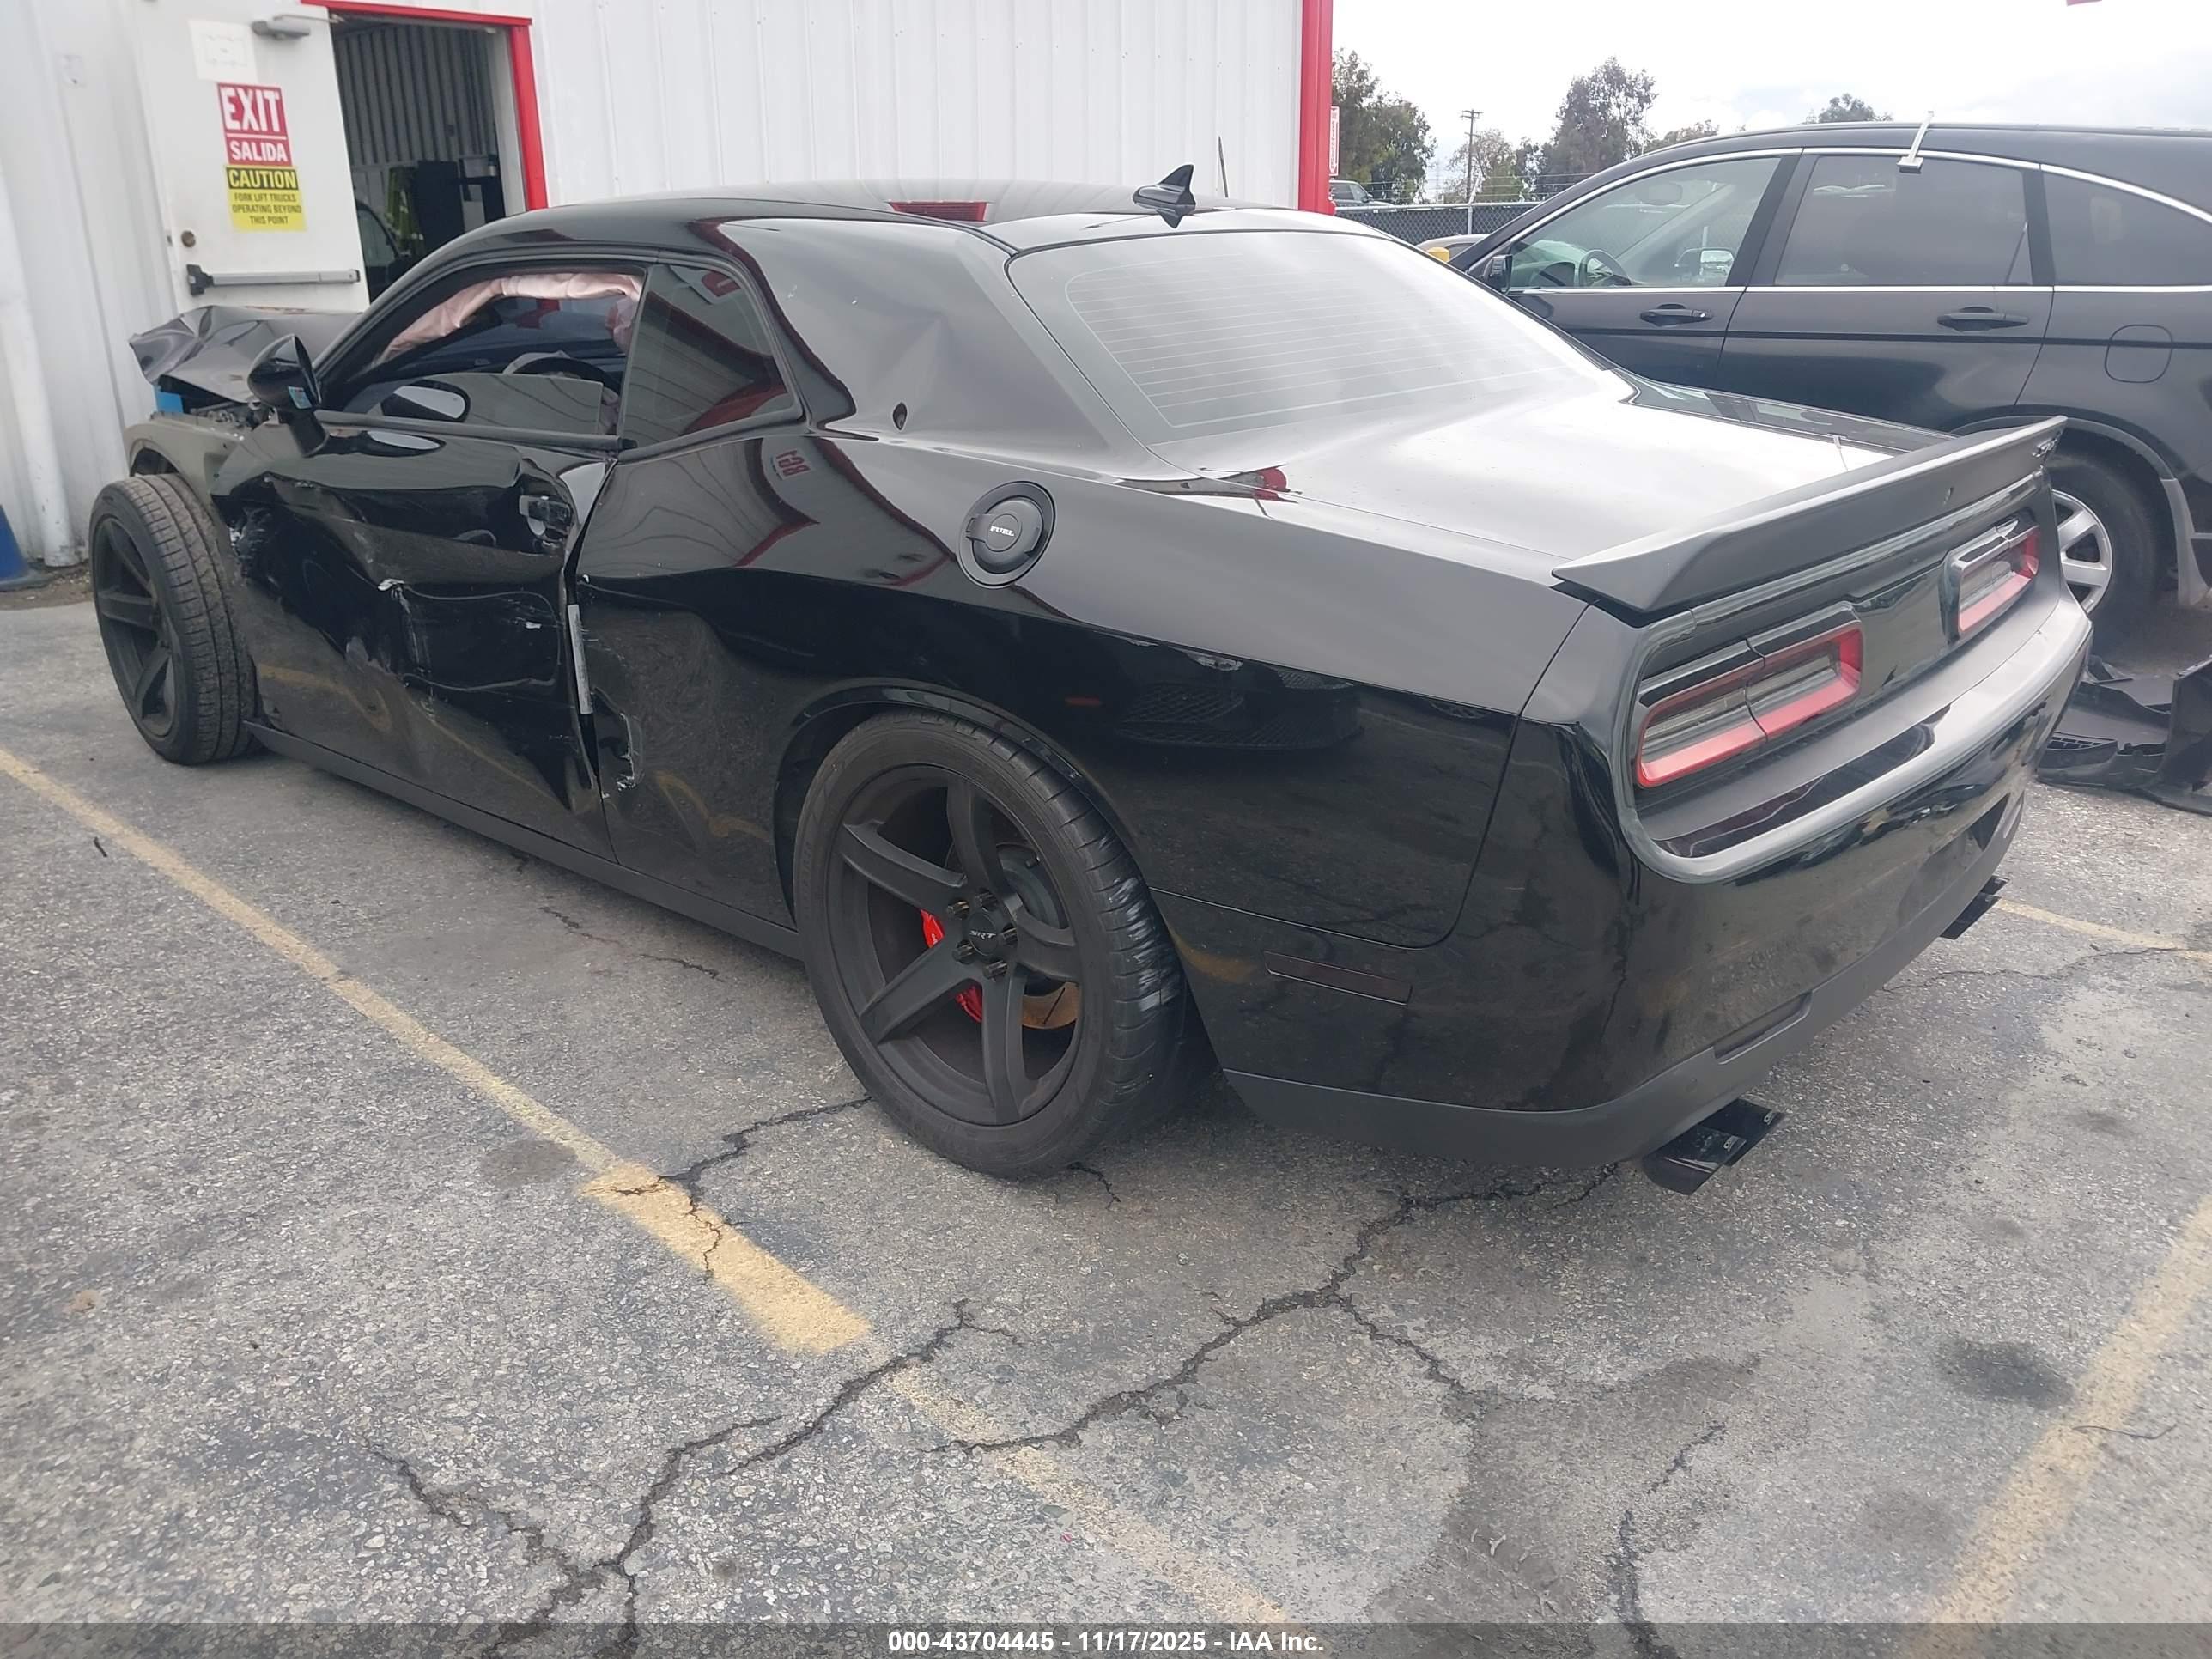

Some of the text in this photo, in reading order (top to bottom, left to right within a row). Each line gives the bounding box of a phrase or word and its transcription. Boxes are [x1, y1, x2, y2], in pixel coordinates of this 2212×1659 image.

[220, 87, 280, 132] EXIT
[229, 140, 289, 162] SALIDA
[228, 169, 297, 189] CAUTION
[234, 192, 296, 203] FORK LIFT TRUCKS
[232, 204, 302, 214] OPERATING BEYOND
[250, 216, 289, 225] THIS POINT
[990, 526, 1015, 537] FUEL
[970, 930, 996, 940] SRT
